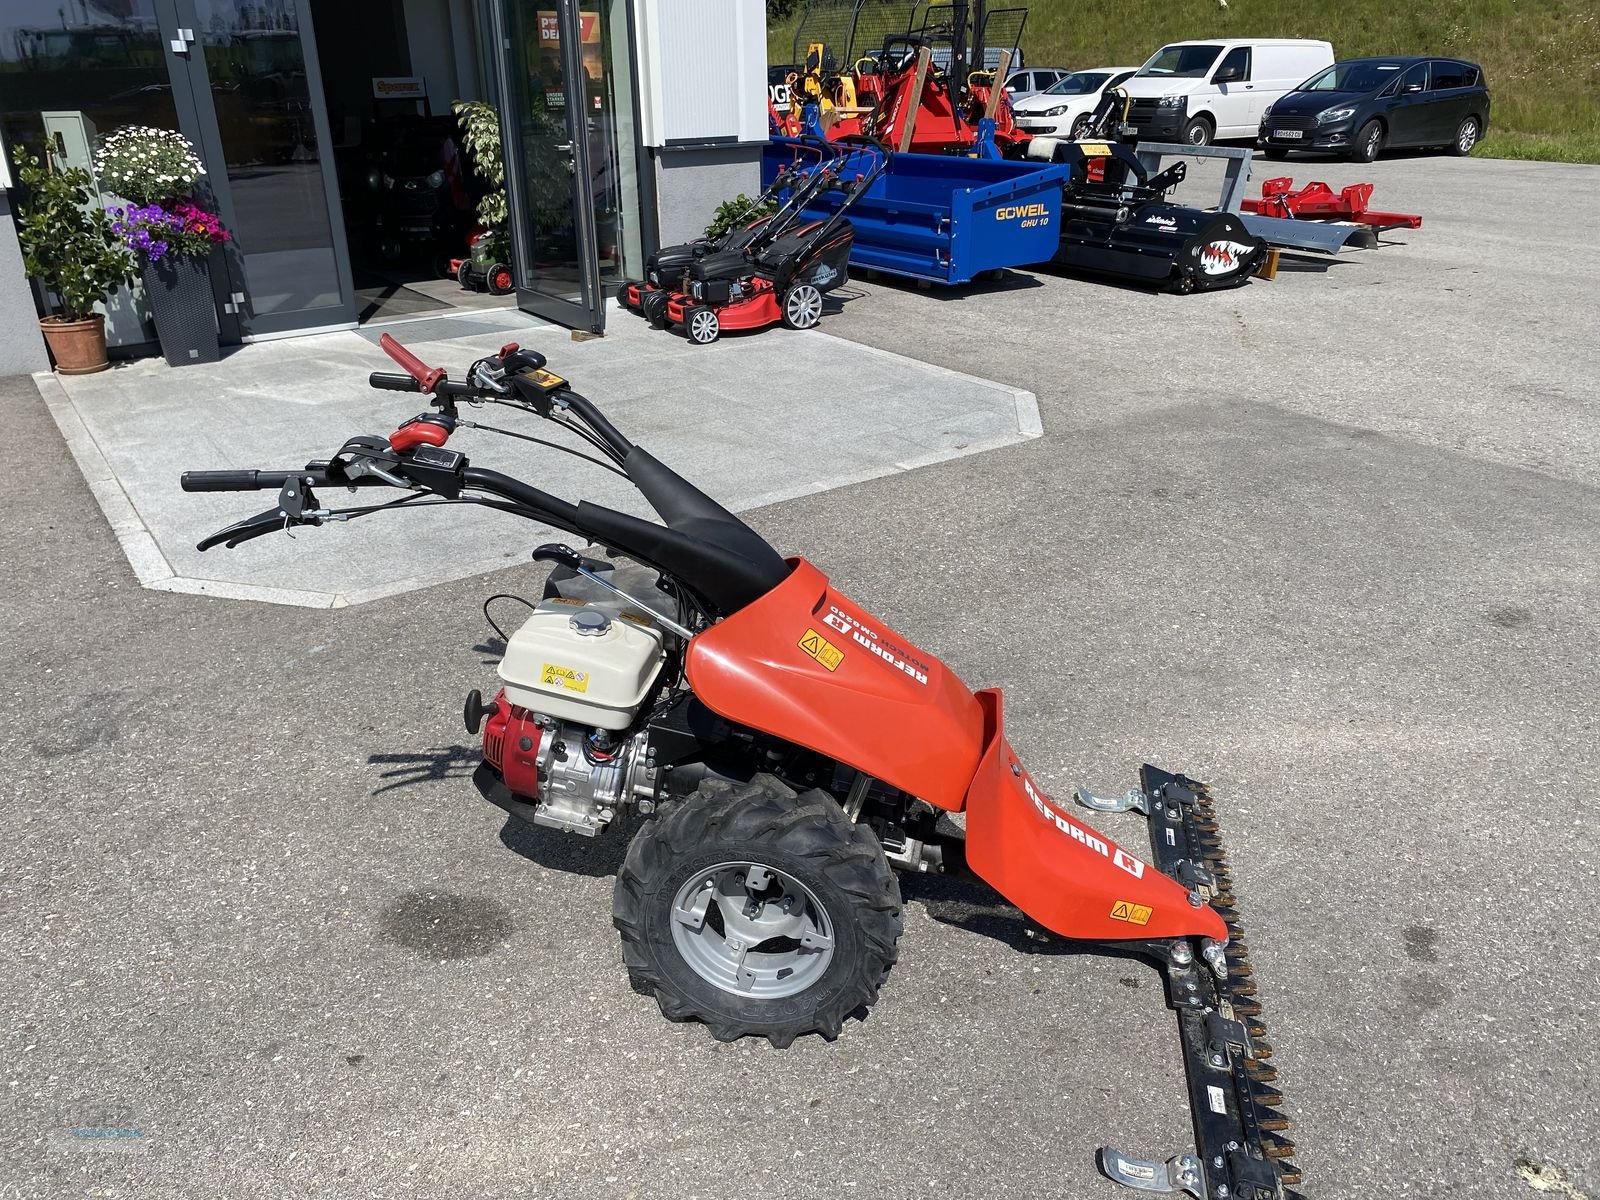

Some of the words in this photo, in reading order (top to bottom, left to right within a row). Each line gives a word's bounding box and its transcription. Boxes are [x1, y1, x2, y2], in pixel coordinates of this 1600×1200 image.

[1021, 218, 1039, 228] GHU
[1039, 217, 1049, 226] 10
[852, 630, 928, 685] REFORM
[1024, 778, 1109, 857] REFORM
